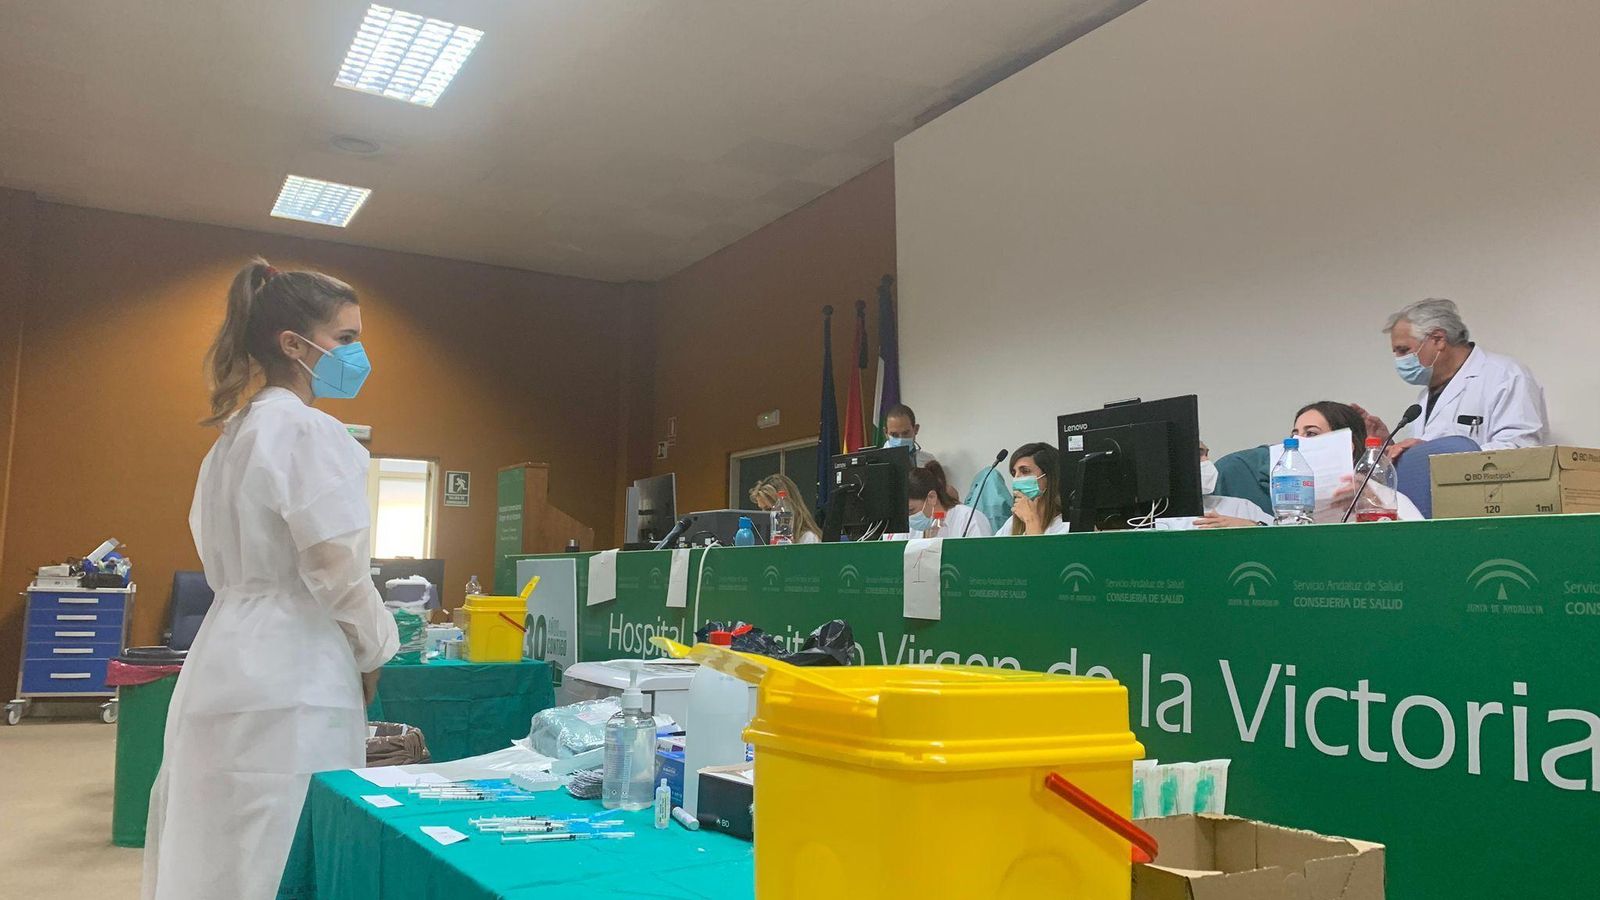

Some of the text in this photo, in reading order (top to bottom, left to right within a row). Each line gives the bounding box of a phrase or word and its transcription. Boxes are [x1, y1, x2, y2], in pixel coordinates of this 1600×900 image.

[1063, 423, 1088, 433] Lenovo
[1484, 505, 1500, 514] 120
[1536, 503, 1554, 513] 1ml
[1293, 580, 1324, 591] Servicio
[1364, 580, 1376, 591] de
[1378, 580, 1403, 592] Salud
[1353, 597, 1367, 609] DE
[1369, 598, 1403, 610] SALUD
[878, 632, 1021, 671] Vir
[1141, 653, 1192, 734] la
[1219, 659, 1600, 792] Victoria
[721, 819, 730, 828] BD
